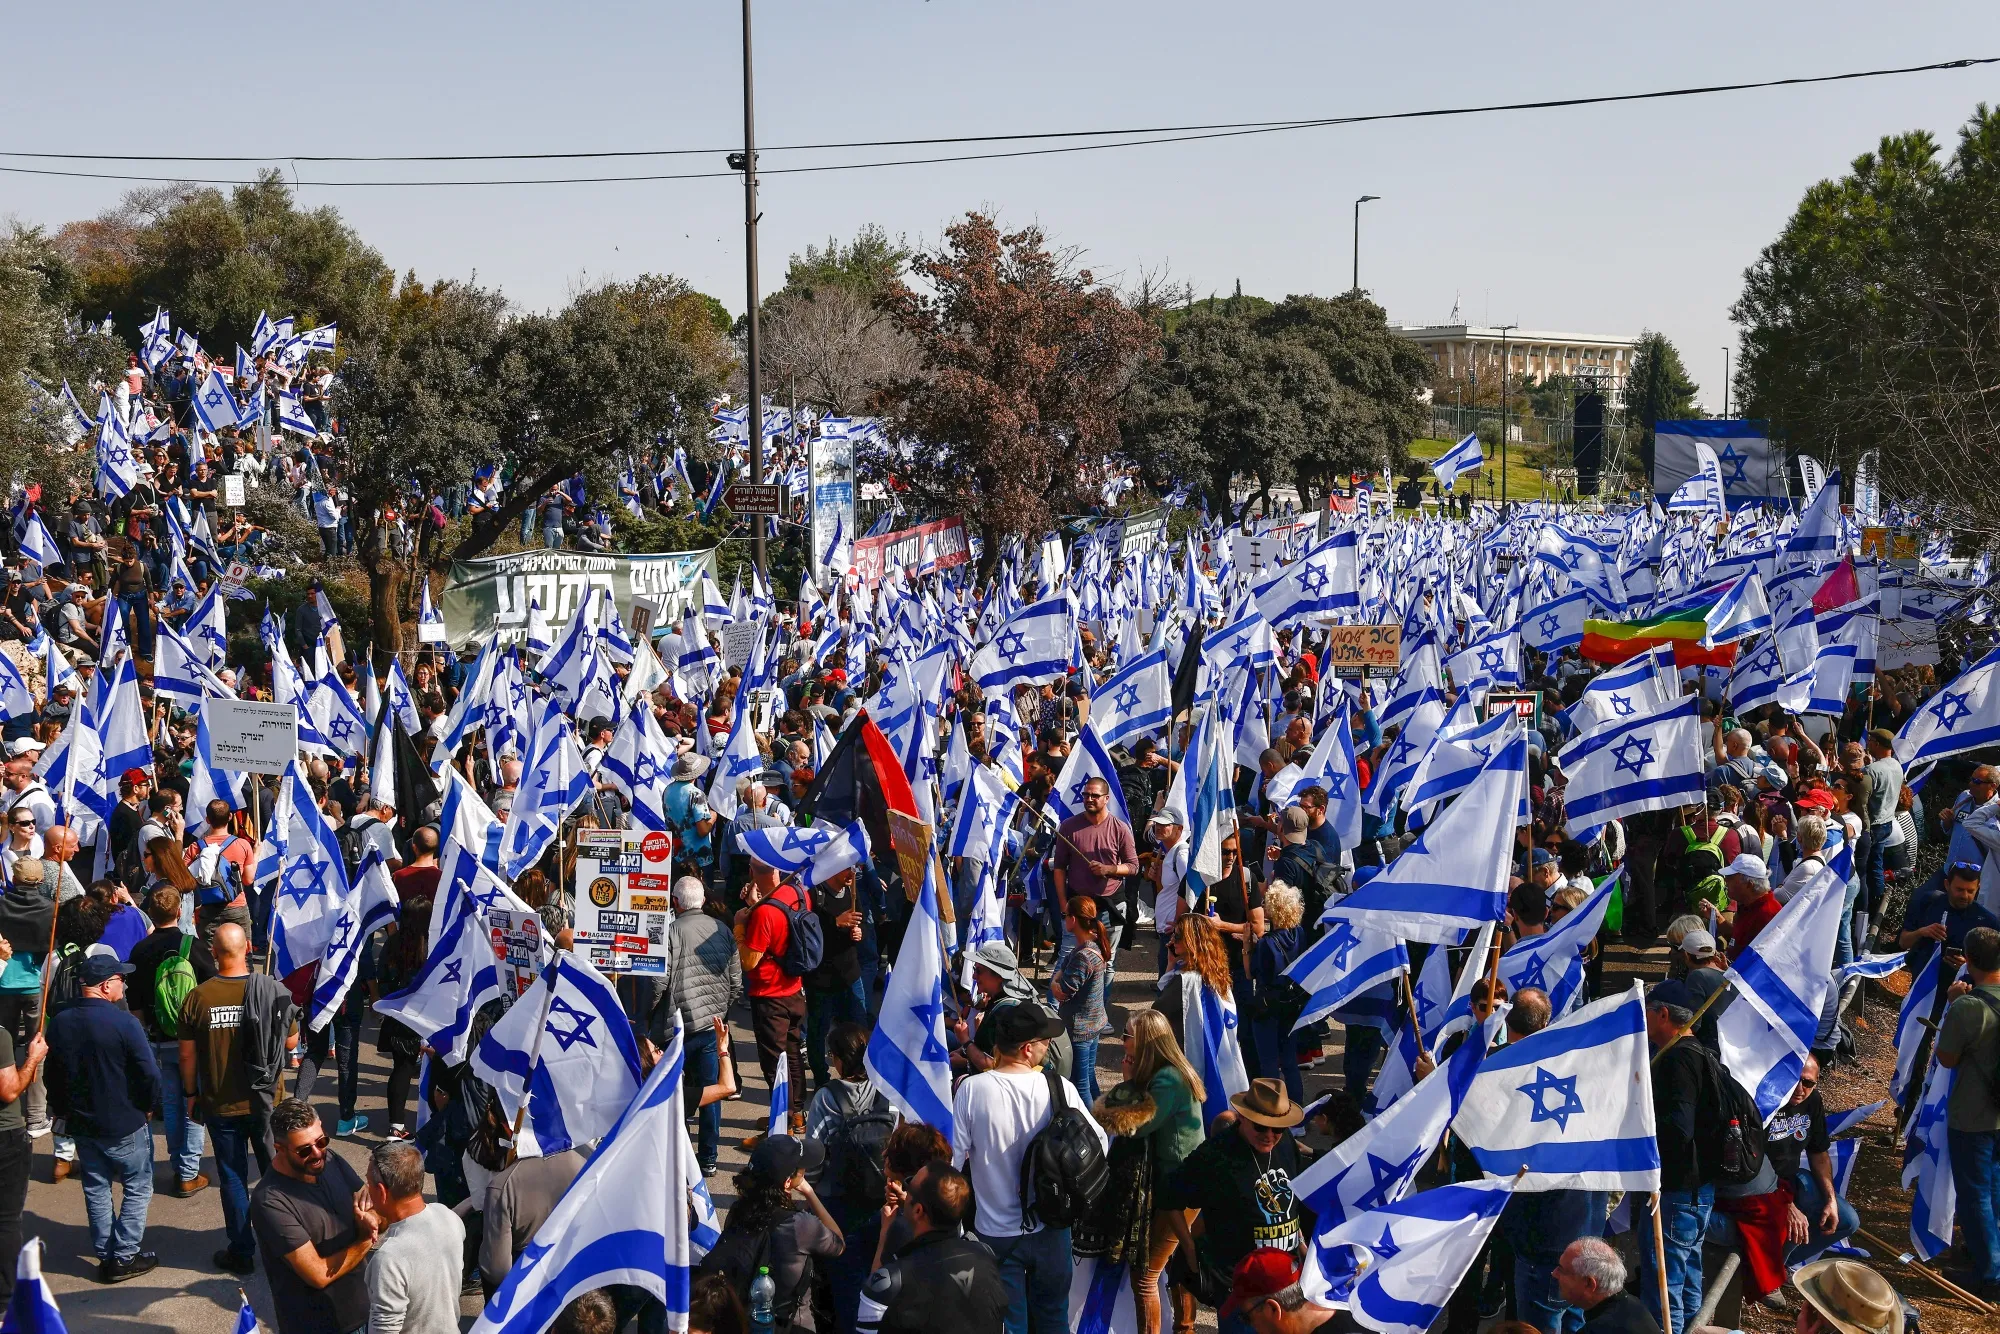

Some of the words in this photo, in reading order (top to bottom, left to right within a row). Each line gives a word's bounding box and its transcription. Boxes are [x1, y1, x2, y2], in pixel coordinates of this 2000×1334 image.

[770, 488, 775, 496] גן
[630, 559, 681, 594] אחים
[492, 574, 615, 624] המסע
[1490, 703, 1522, 714] אתוק!
[259, 721, 291, 730] החירות,
[241, 732, 264, 743] הצדק
[217, 740, 247, 753] והשלום
[602, 854, 640, 867] נאמנם
[597, 883, 610, 892] לא
[601, 913, 636, 925] נאמנים
[1254, 1218, 1299, 1238] מוקרטיה
